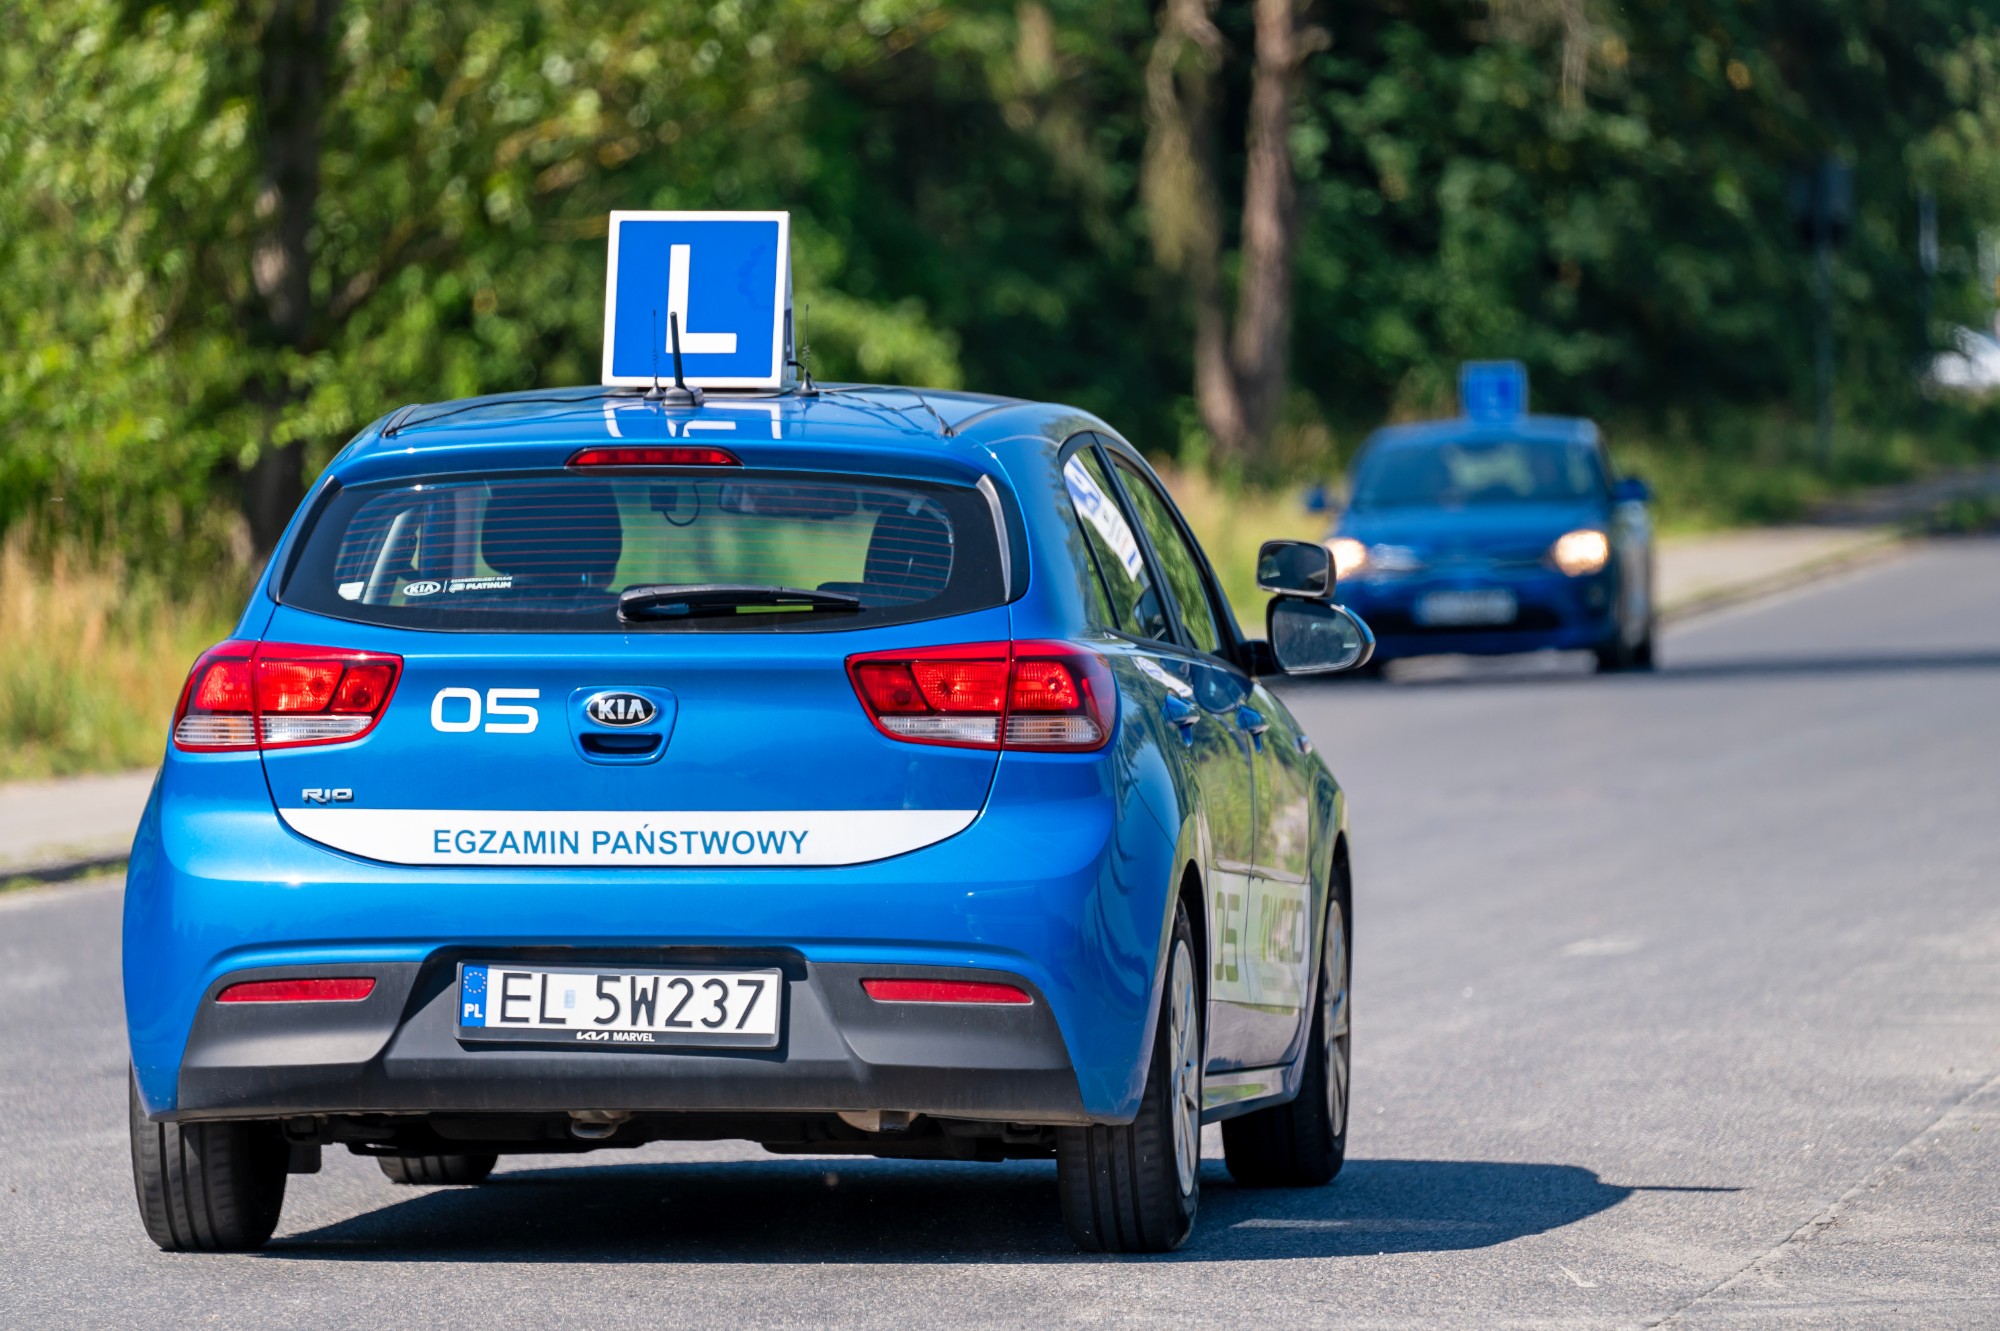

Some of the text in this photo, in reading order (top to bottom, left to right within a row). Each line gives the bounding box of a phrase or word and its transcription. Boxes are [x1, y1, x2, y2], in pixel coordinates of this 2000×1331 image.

[665, 244, 738, 354] L
[466, 581, 512, 590] PLATINUM
[430, 687, 540, 734] 05
[597, 698, 647, 721] KIA
[302, 787, 353, 804] RIO
[433, 823, 809, 855] EGZAMIN PAŃSTWOWY
[463, 1003, 483, 1019] PL
[499, 972, 766, 1030] EL 5W237
[612, 1032, 655, 1043] MARVEL
